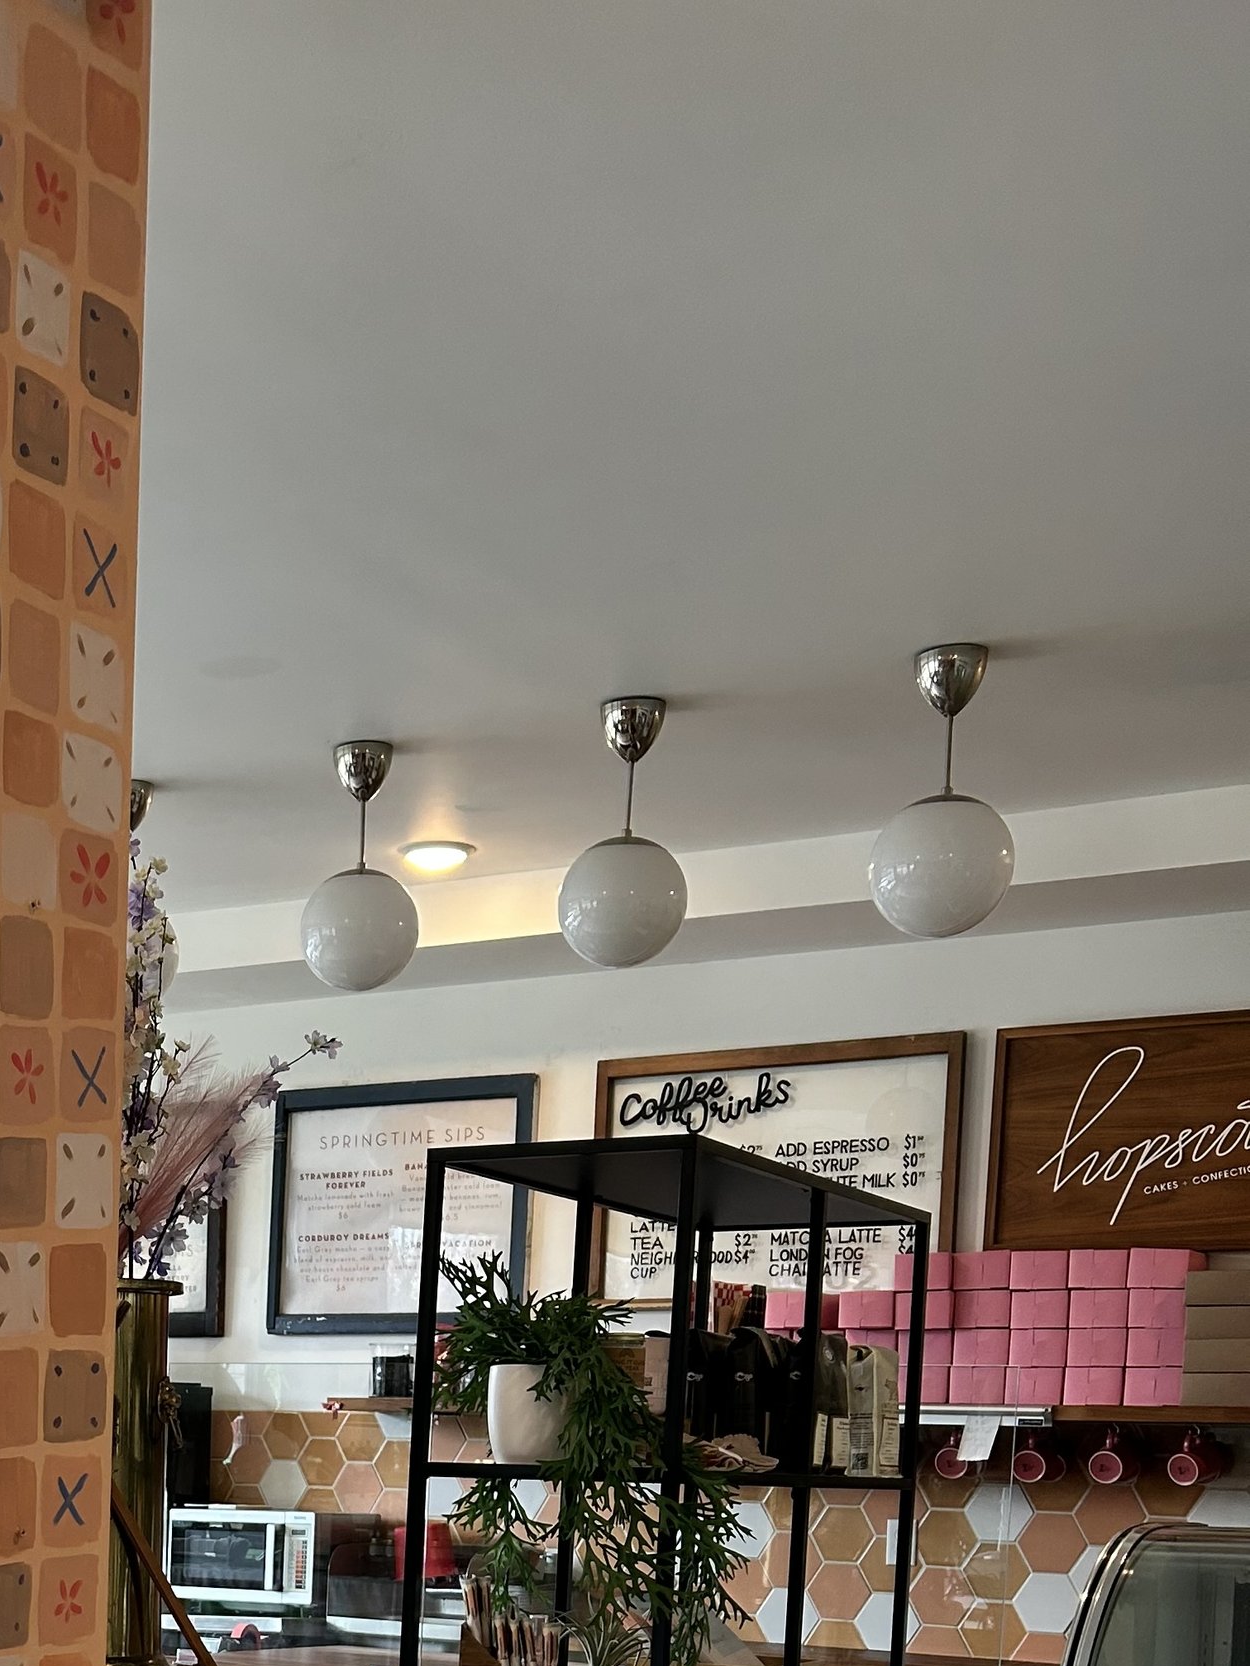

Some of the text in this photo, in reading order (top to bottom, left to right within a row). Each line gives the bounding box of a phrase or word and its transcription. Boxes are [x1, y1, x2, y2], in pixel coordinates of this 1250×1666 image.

[618, 1071, 792, 1135] Coffee Drinks
[319, 1126, 486, 1151] SPRINGTIME SIPS
[1036, 1045, 1250, 1226] hopsco
[774, 1142, 809, 1158] ADD
[812, 1136, 891, 1157] ESPRESSO
[780, 1160, 808, 1173] DD
[812, 1157, 860, 1174] SYRUP
[299, 1168, 394, 1181] STRAWBERRY FIELDS
[862, 1172, 896, 1189] MILK
[325, 1181, 366, 1190] FOREVER
[1143, 1180, 1179, 1196] CAKES
[629, 1220, 676, 1234] LATTE
[298, 1232, 390, 1243] CORDUROY DREAMS
[629, 1236, 664, 1251] TEA
[770, 1231, 832, 1246] MATCA
[838, 1227, 883, 1244] LATTE
[769, 1247, 830, 1263] LONDN
[834, 1246, 865, 1261] FOG
[629, 1266, 658, 1280] CUP
[768, 1260, 862, 1278] CHAI ATTE
